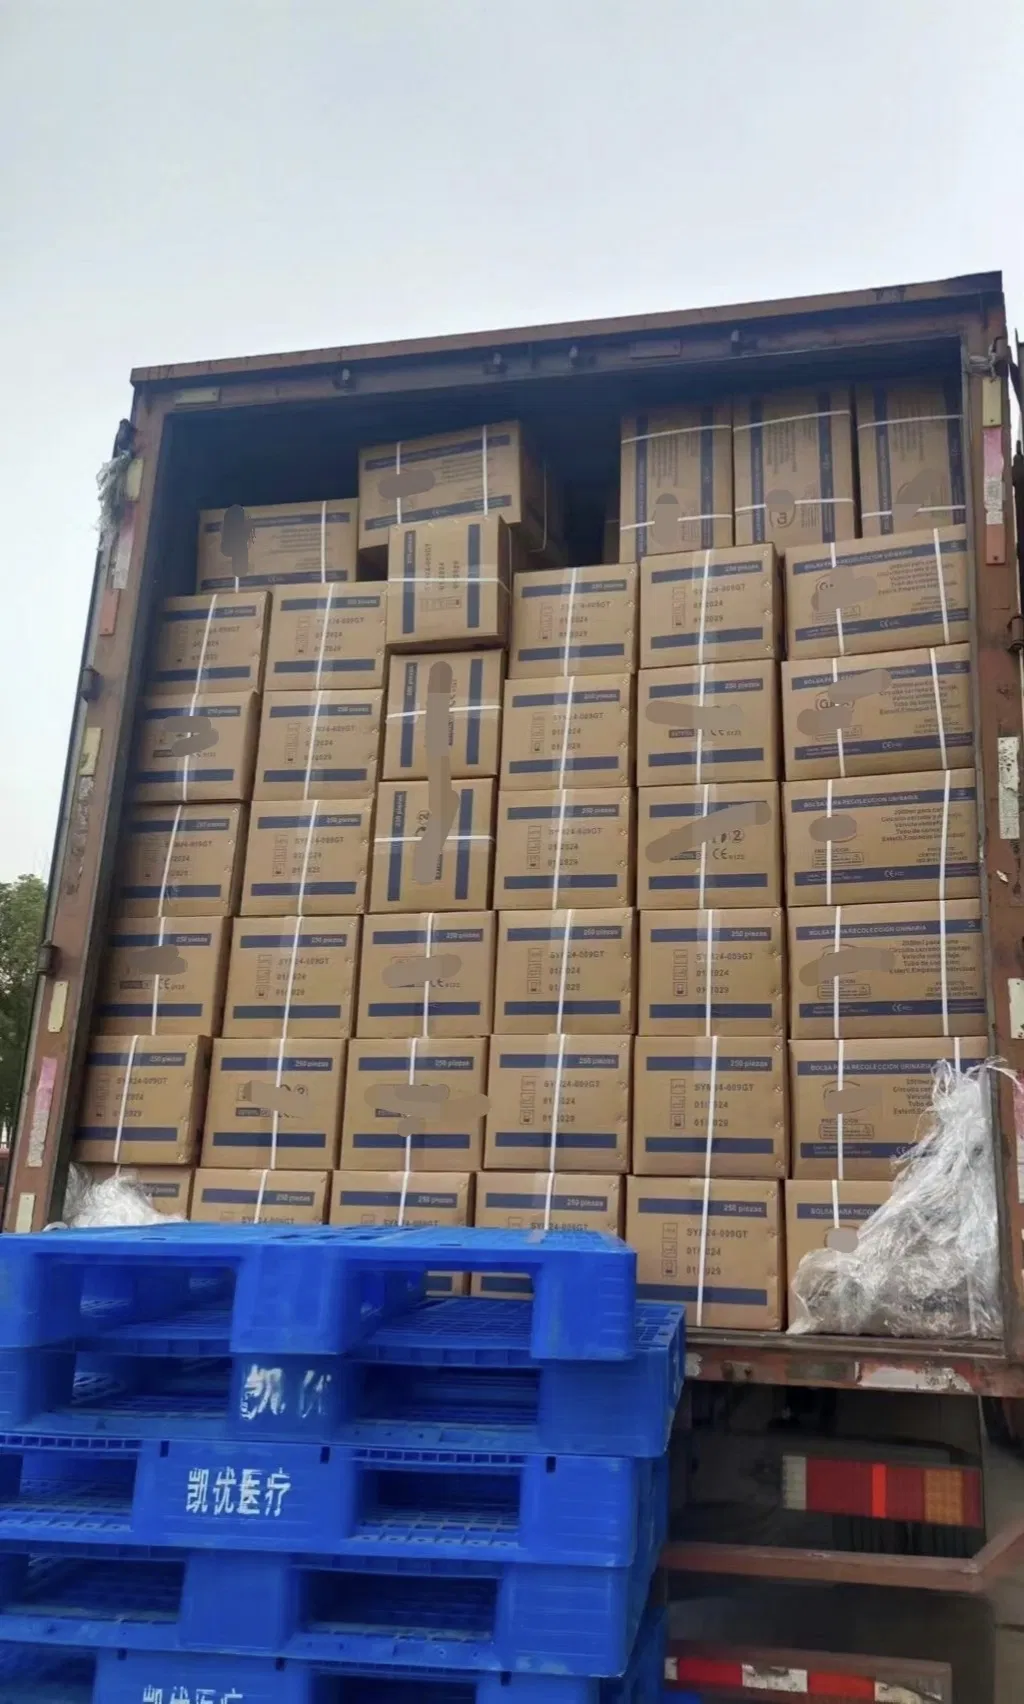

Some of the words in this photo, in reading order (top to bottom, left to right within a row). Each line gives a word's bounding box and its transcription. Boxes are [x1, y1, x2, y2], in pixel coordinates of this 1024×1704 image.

[730, 1059, 744, 1067] 250
[724, 1203, 737, 1212] 250
[738, 1205, 763, 1214] piezas
[186, 1465, 292, 1518] 凯优医疗
